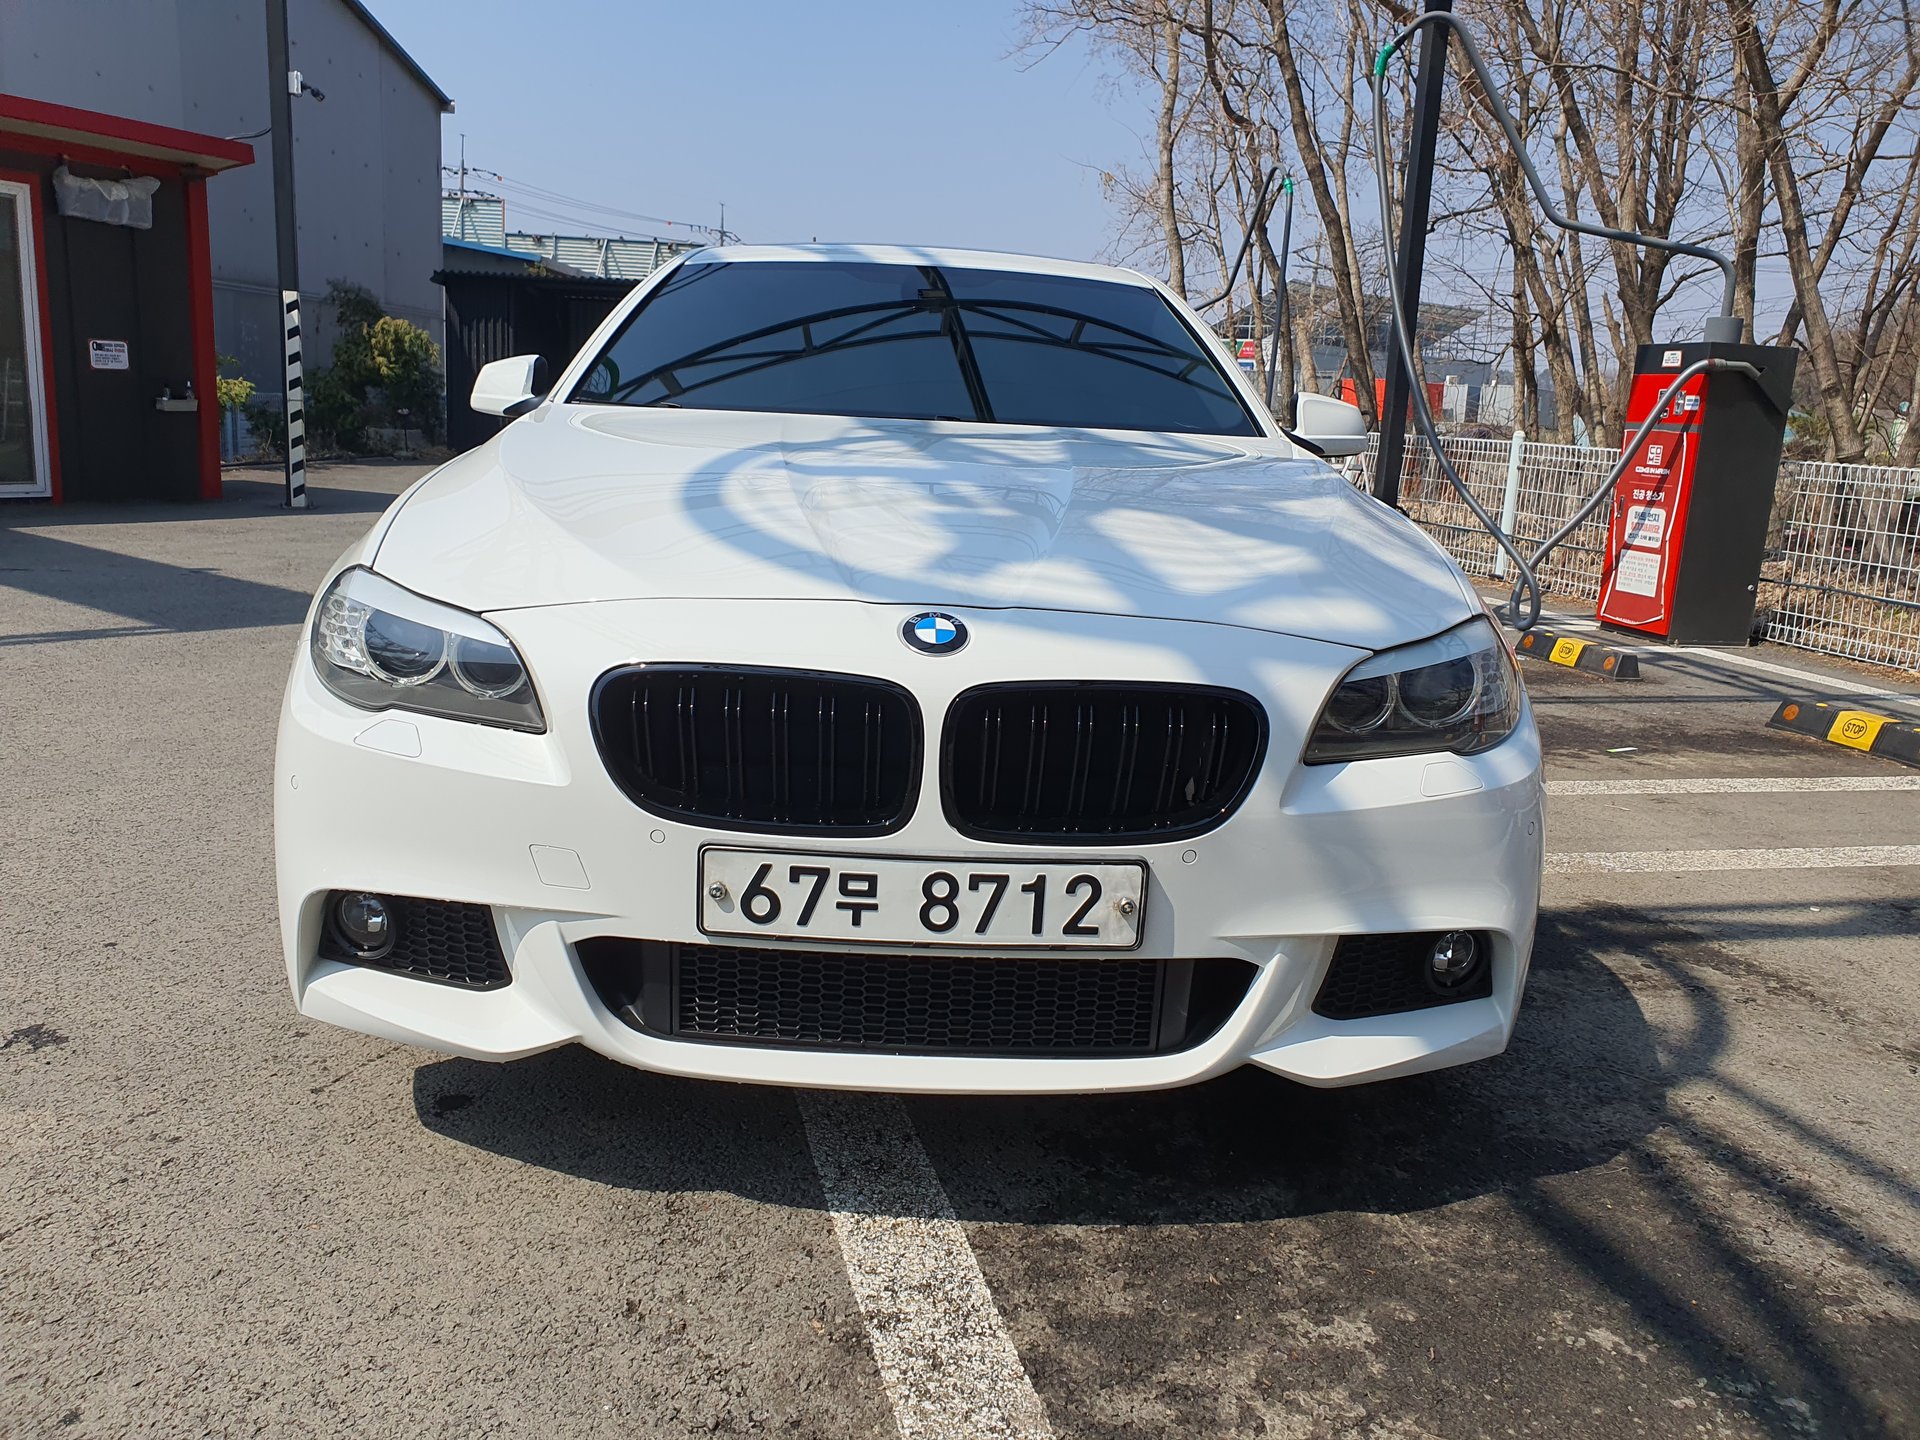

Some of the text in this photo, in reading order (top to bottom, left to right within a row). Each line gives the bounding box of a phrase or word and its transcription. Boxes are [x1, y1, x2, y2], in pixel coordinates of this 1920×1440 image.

[1633, 489, 1665, 502] 진공 청소기
[1844, 721, 1865, 735] STOP
[739, 862, 1103, 936] 67무 8712
